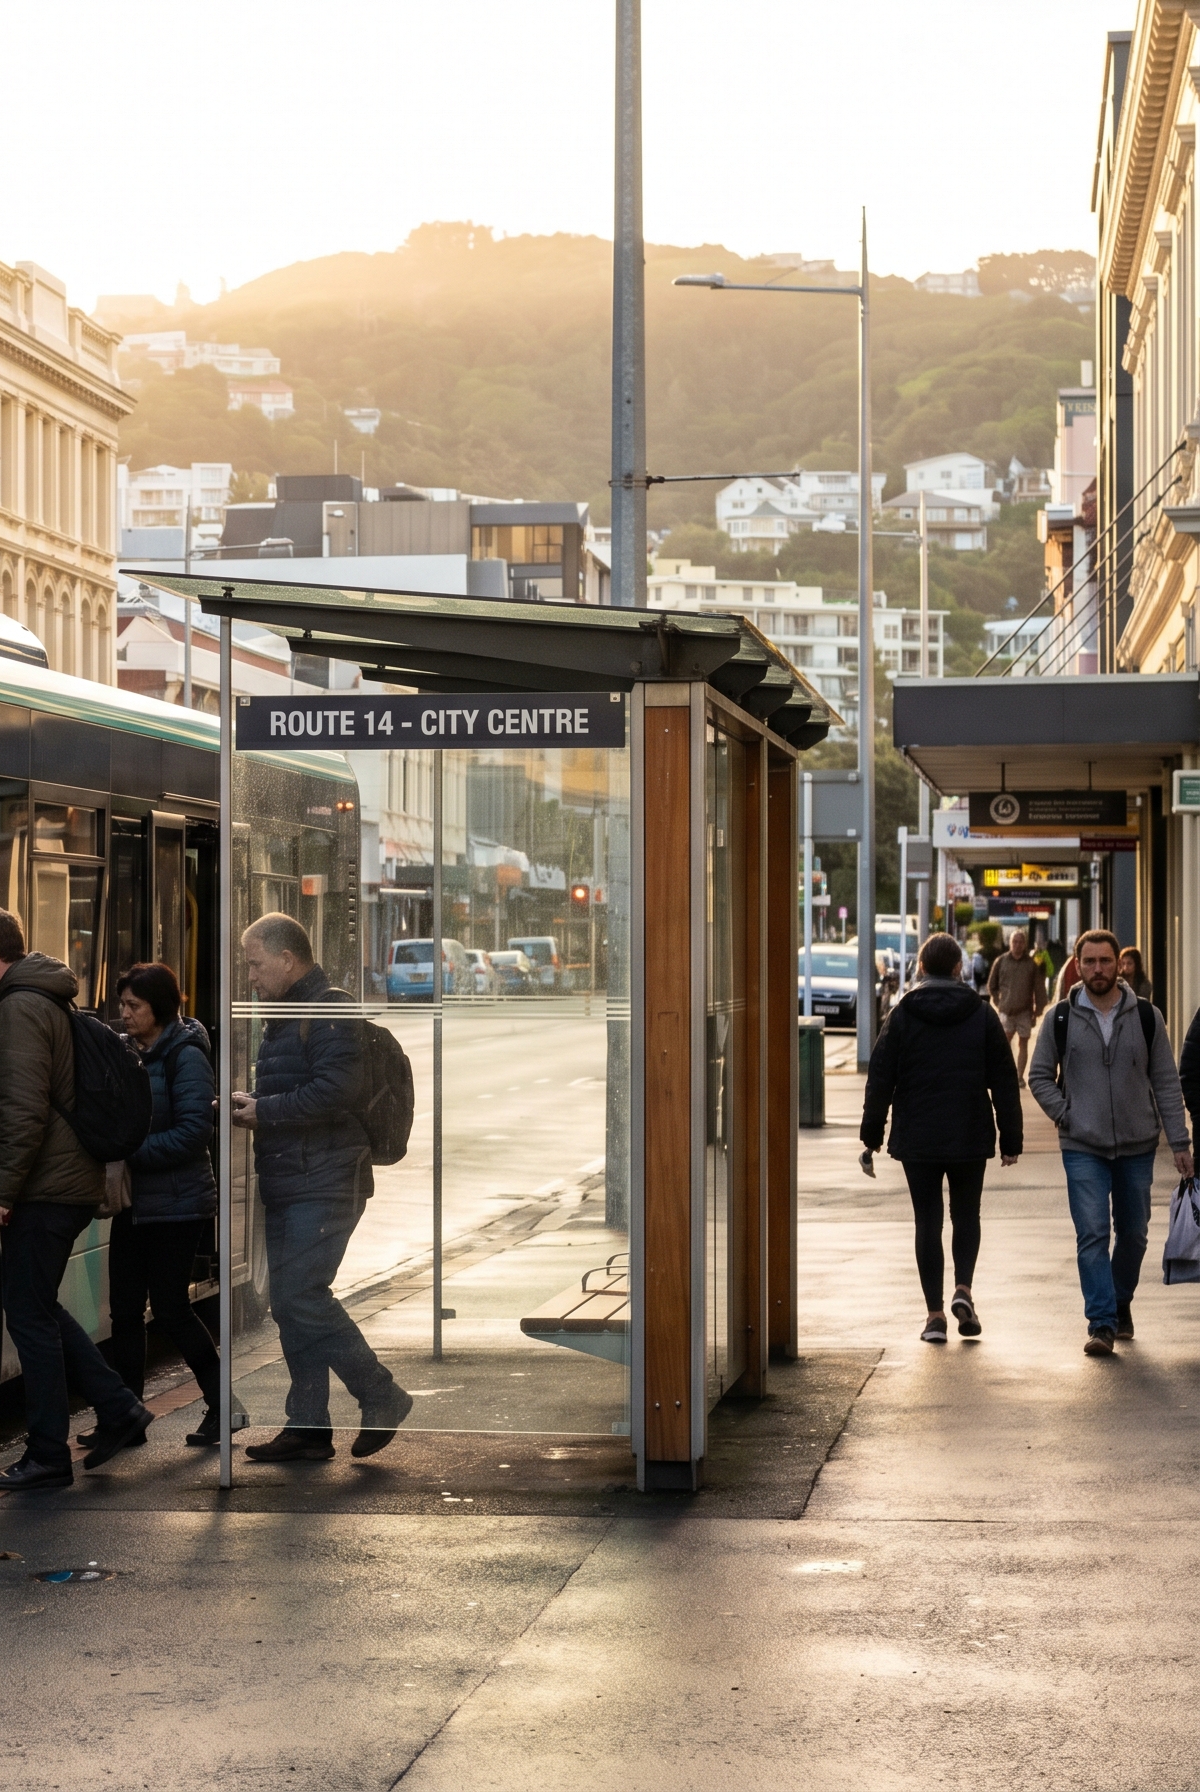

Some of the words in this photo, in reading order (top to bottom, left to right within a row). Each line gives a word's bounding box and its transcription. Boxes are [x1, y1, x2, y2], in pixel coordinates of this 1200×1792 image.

[270, 710, 355, 736] ROUTE
[363, 710, 394, 736] 14
[420, 709, 480, 736] CITY
[487, 708, 589, 735] CENTRE
